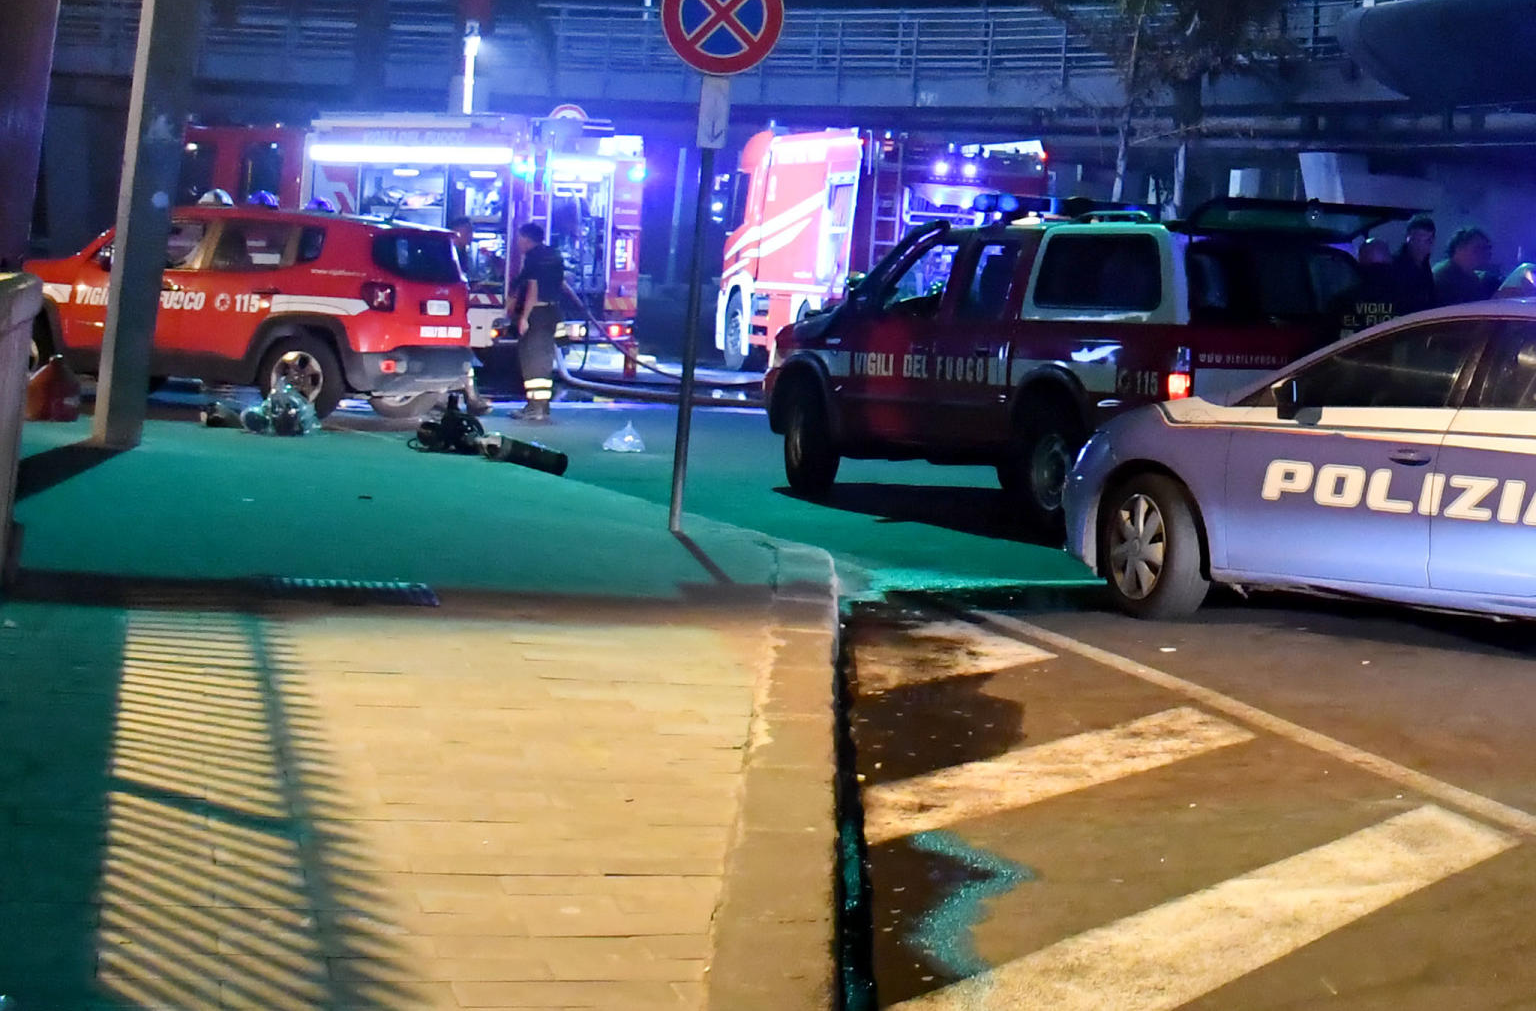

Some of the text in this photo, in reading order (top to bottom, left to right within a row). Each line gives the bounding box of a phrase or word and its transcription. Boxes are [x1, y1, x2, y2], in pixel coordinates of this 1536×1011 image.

[75, 285, 109, 306] VIGI
[235, 294, 260, 313] 115
[1355, 302, 1393, 314] VIGILI
[854, 351, 1159, 396] VIGILI DEL FUOCO 115
